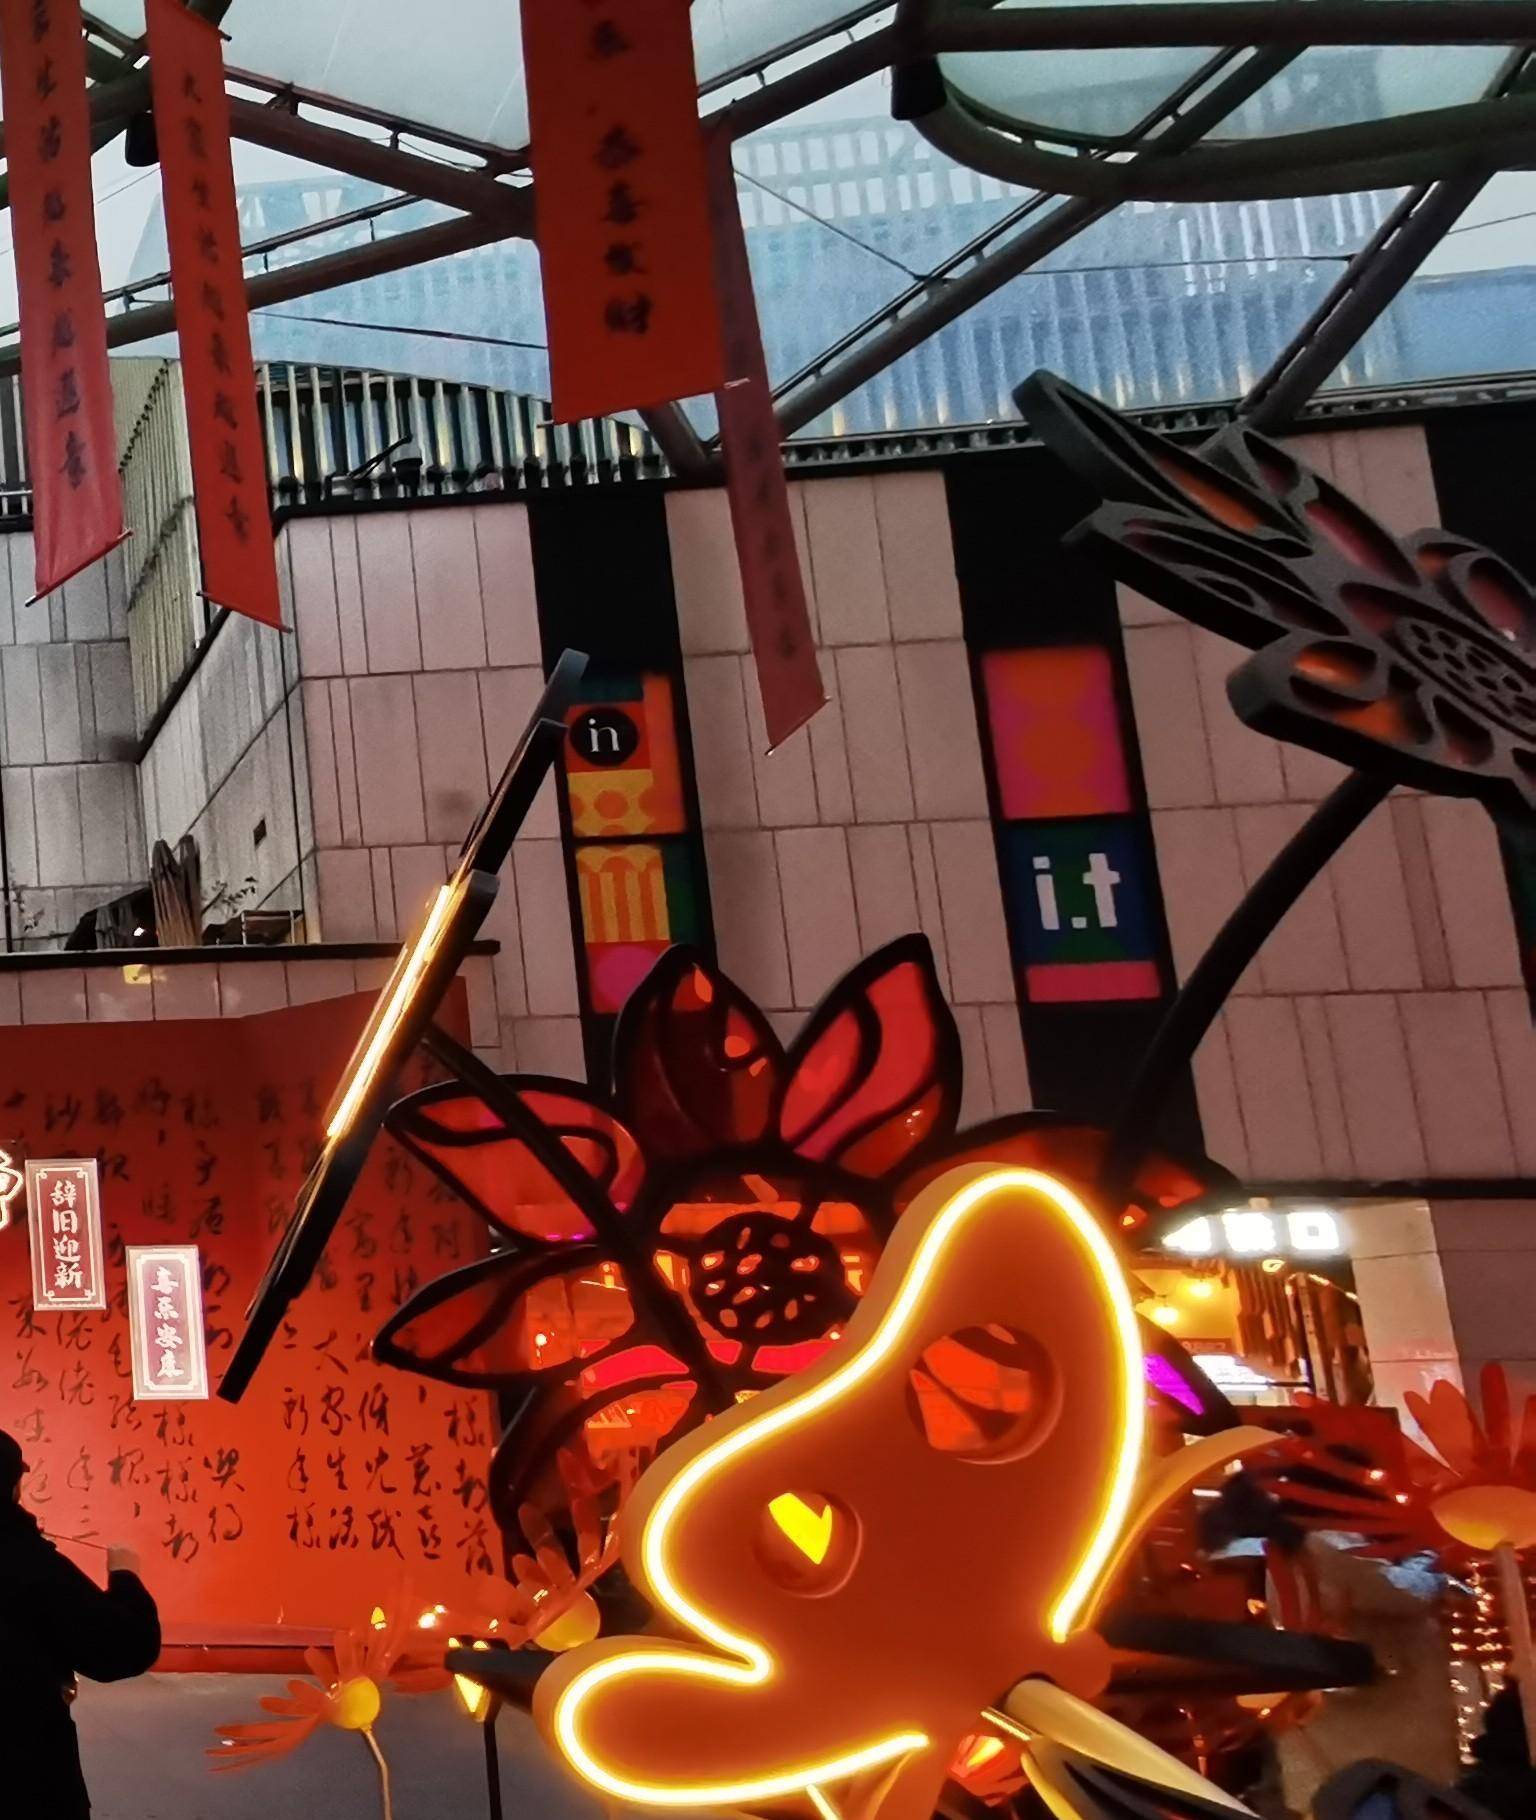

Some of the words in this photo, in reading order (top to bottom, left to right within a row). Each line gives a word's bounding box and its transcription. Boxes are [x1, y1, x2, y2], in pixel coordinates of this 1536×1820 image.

[1032, 852, 1121, 931] i.t
[50, 1180, 84, 1289] 辞旧迎新
